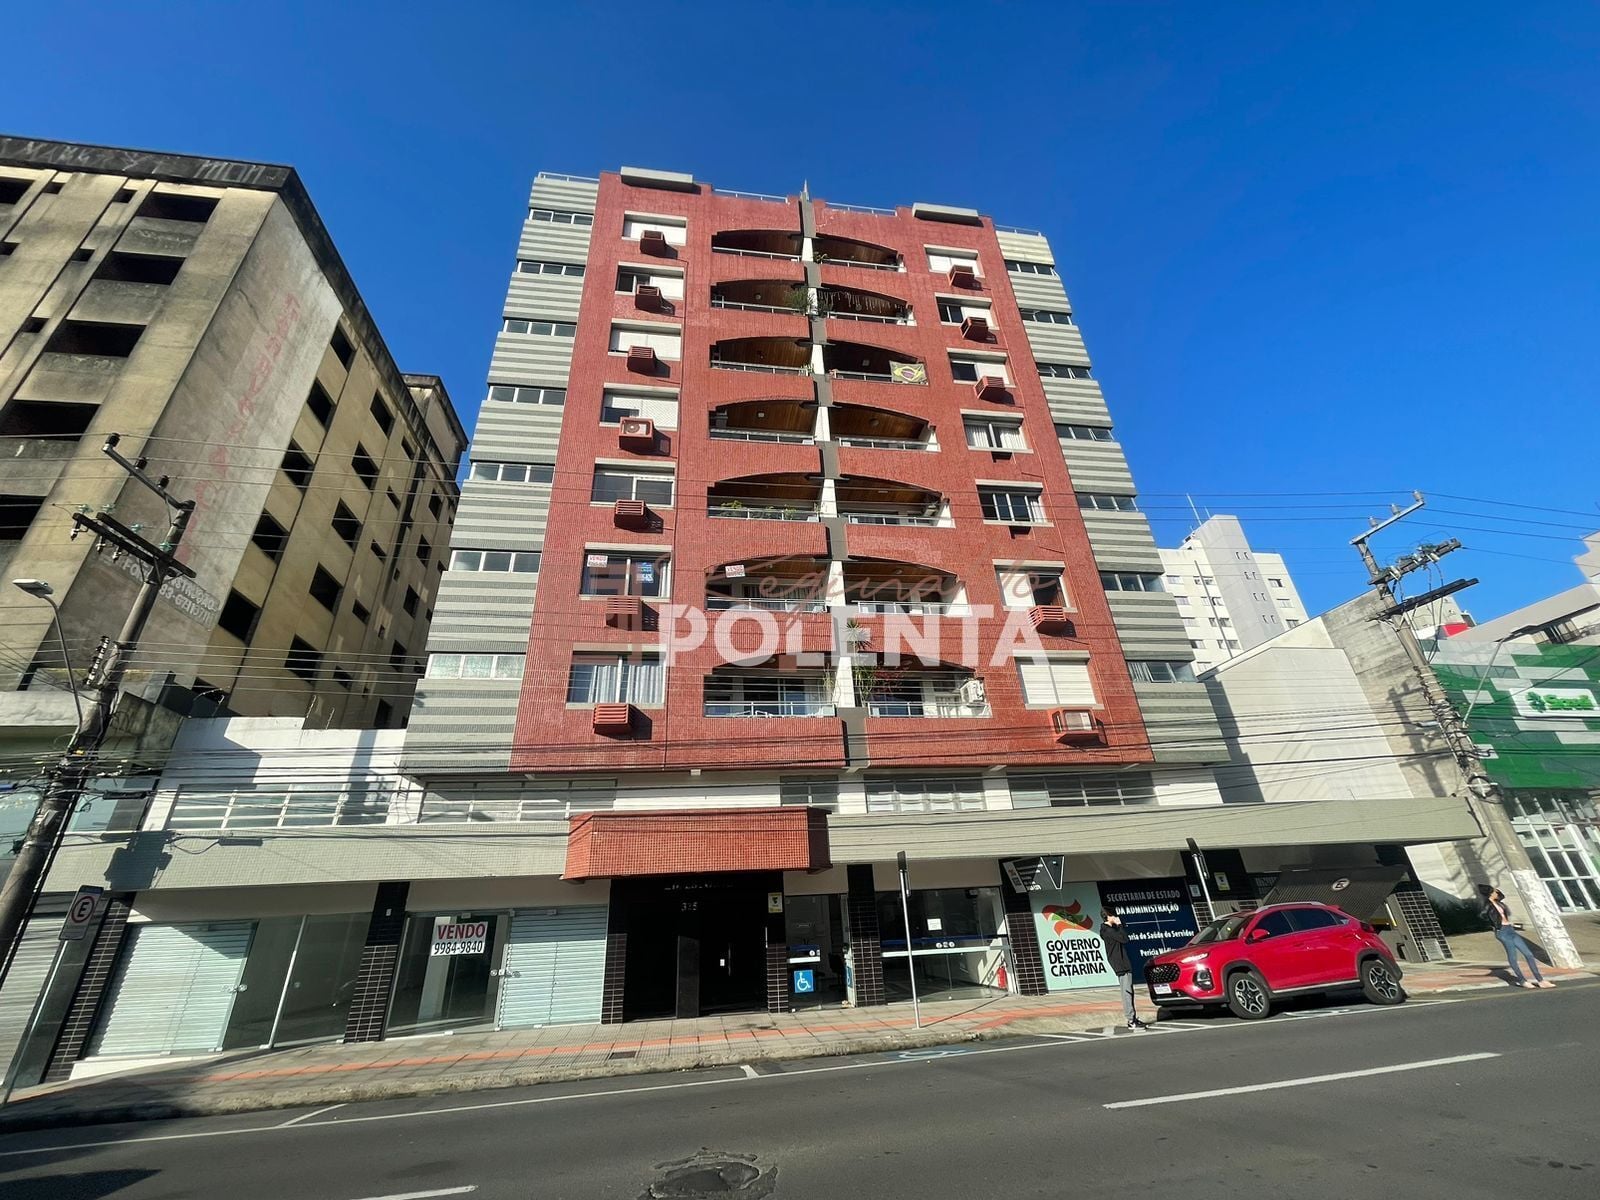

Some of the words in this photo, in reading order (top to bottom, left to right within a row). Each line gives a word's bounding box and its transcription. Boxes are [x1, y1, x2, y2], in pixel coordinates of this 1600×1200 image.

[1106, 891, 1146, 902] SECRETARIA
[1146, 890, 1156, 900] DE
[1156, 890, 1180, 899] ESTADO
[1115, 906, 1126, 915] DA
[1126, 902, 1179, 914] ADMINISTRAÇÃO
[437, 923, 486, 940] VENDO
[1171, 929, 1195, 938] Servidor
[434, 941, 483, 955] 9984-9840
[1046, 938, 1101, 951] GOVERNO
[1048, 952, 1064, 964] DE
[1066, 950, 1104, 963] SANTA
[1051, 962, 1107, 977] CATARINA
